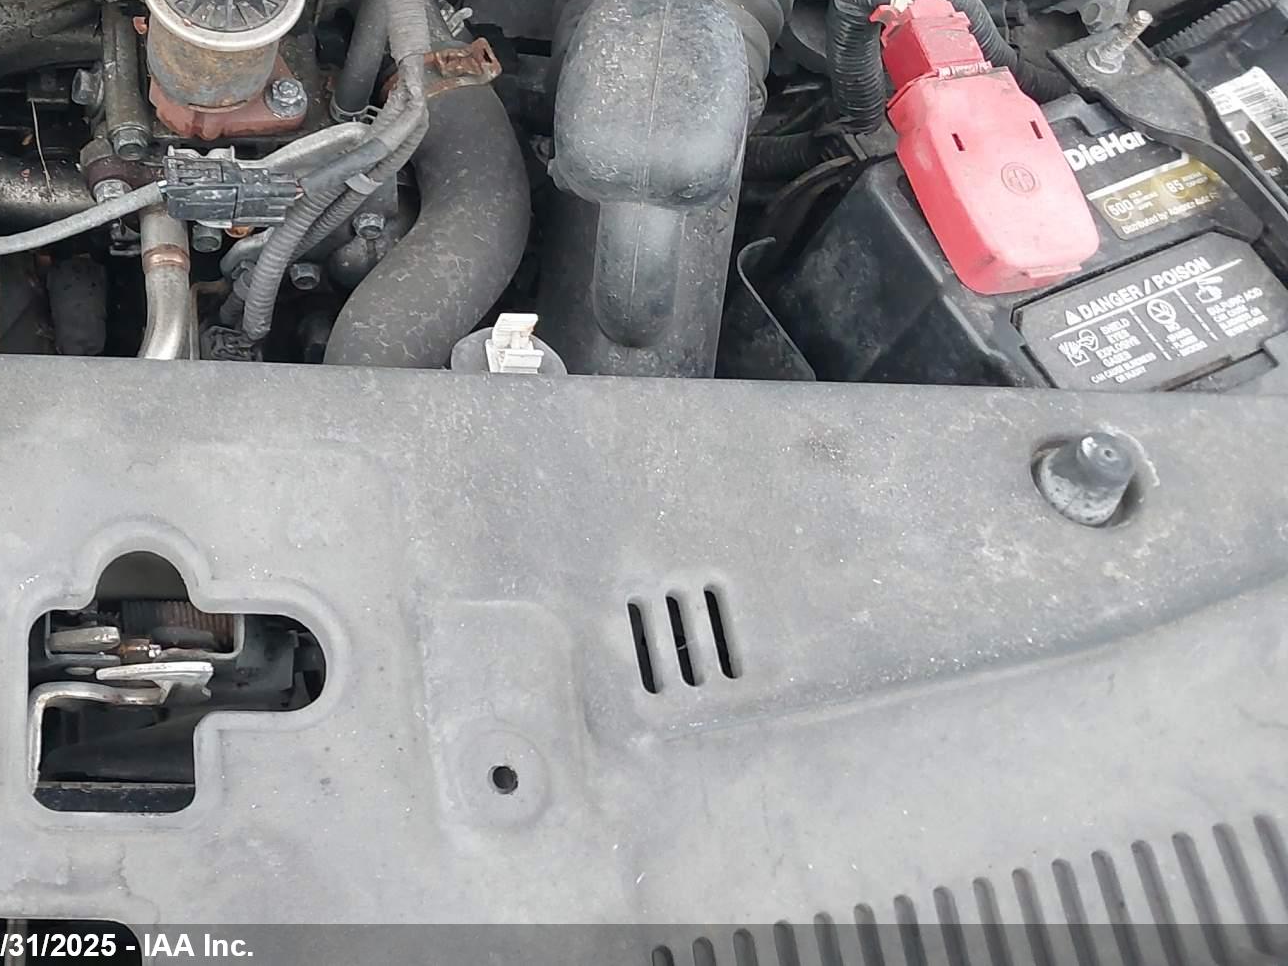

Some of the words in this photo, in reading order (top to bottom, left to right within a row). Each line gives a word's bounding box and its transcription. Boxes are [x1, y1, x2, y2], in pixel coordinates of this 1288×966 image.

[1063, 130, 1155, 163] DieHar
[1077, 283, 1145, 320] DANGER
[1151, 256, 1212, 290] POISON
